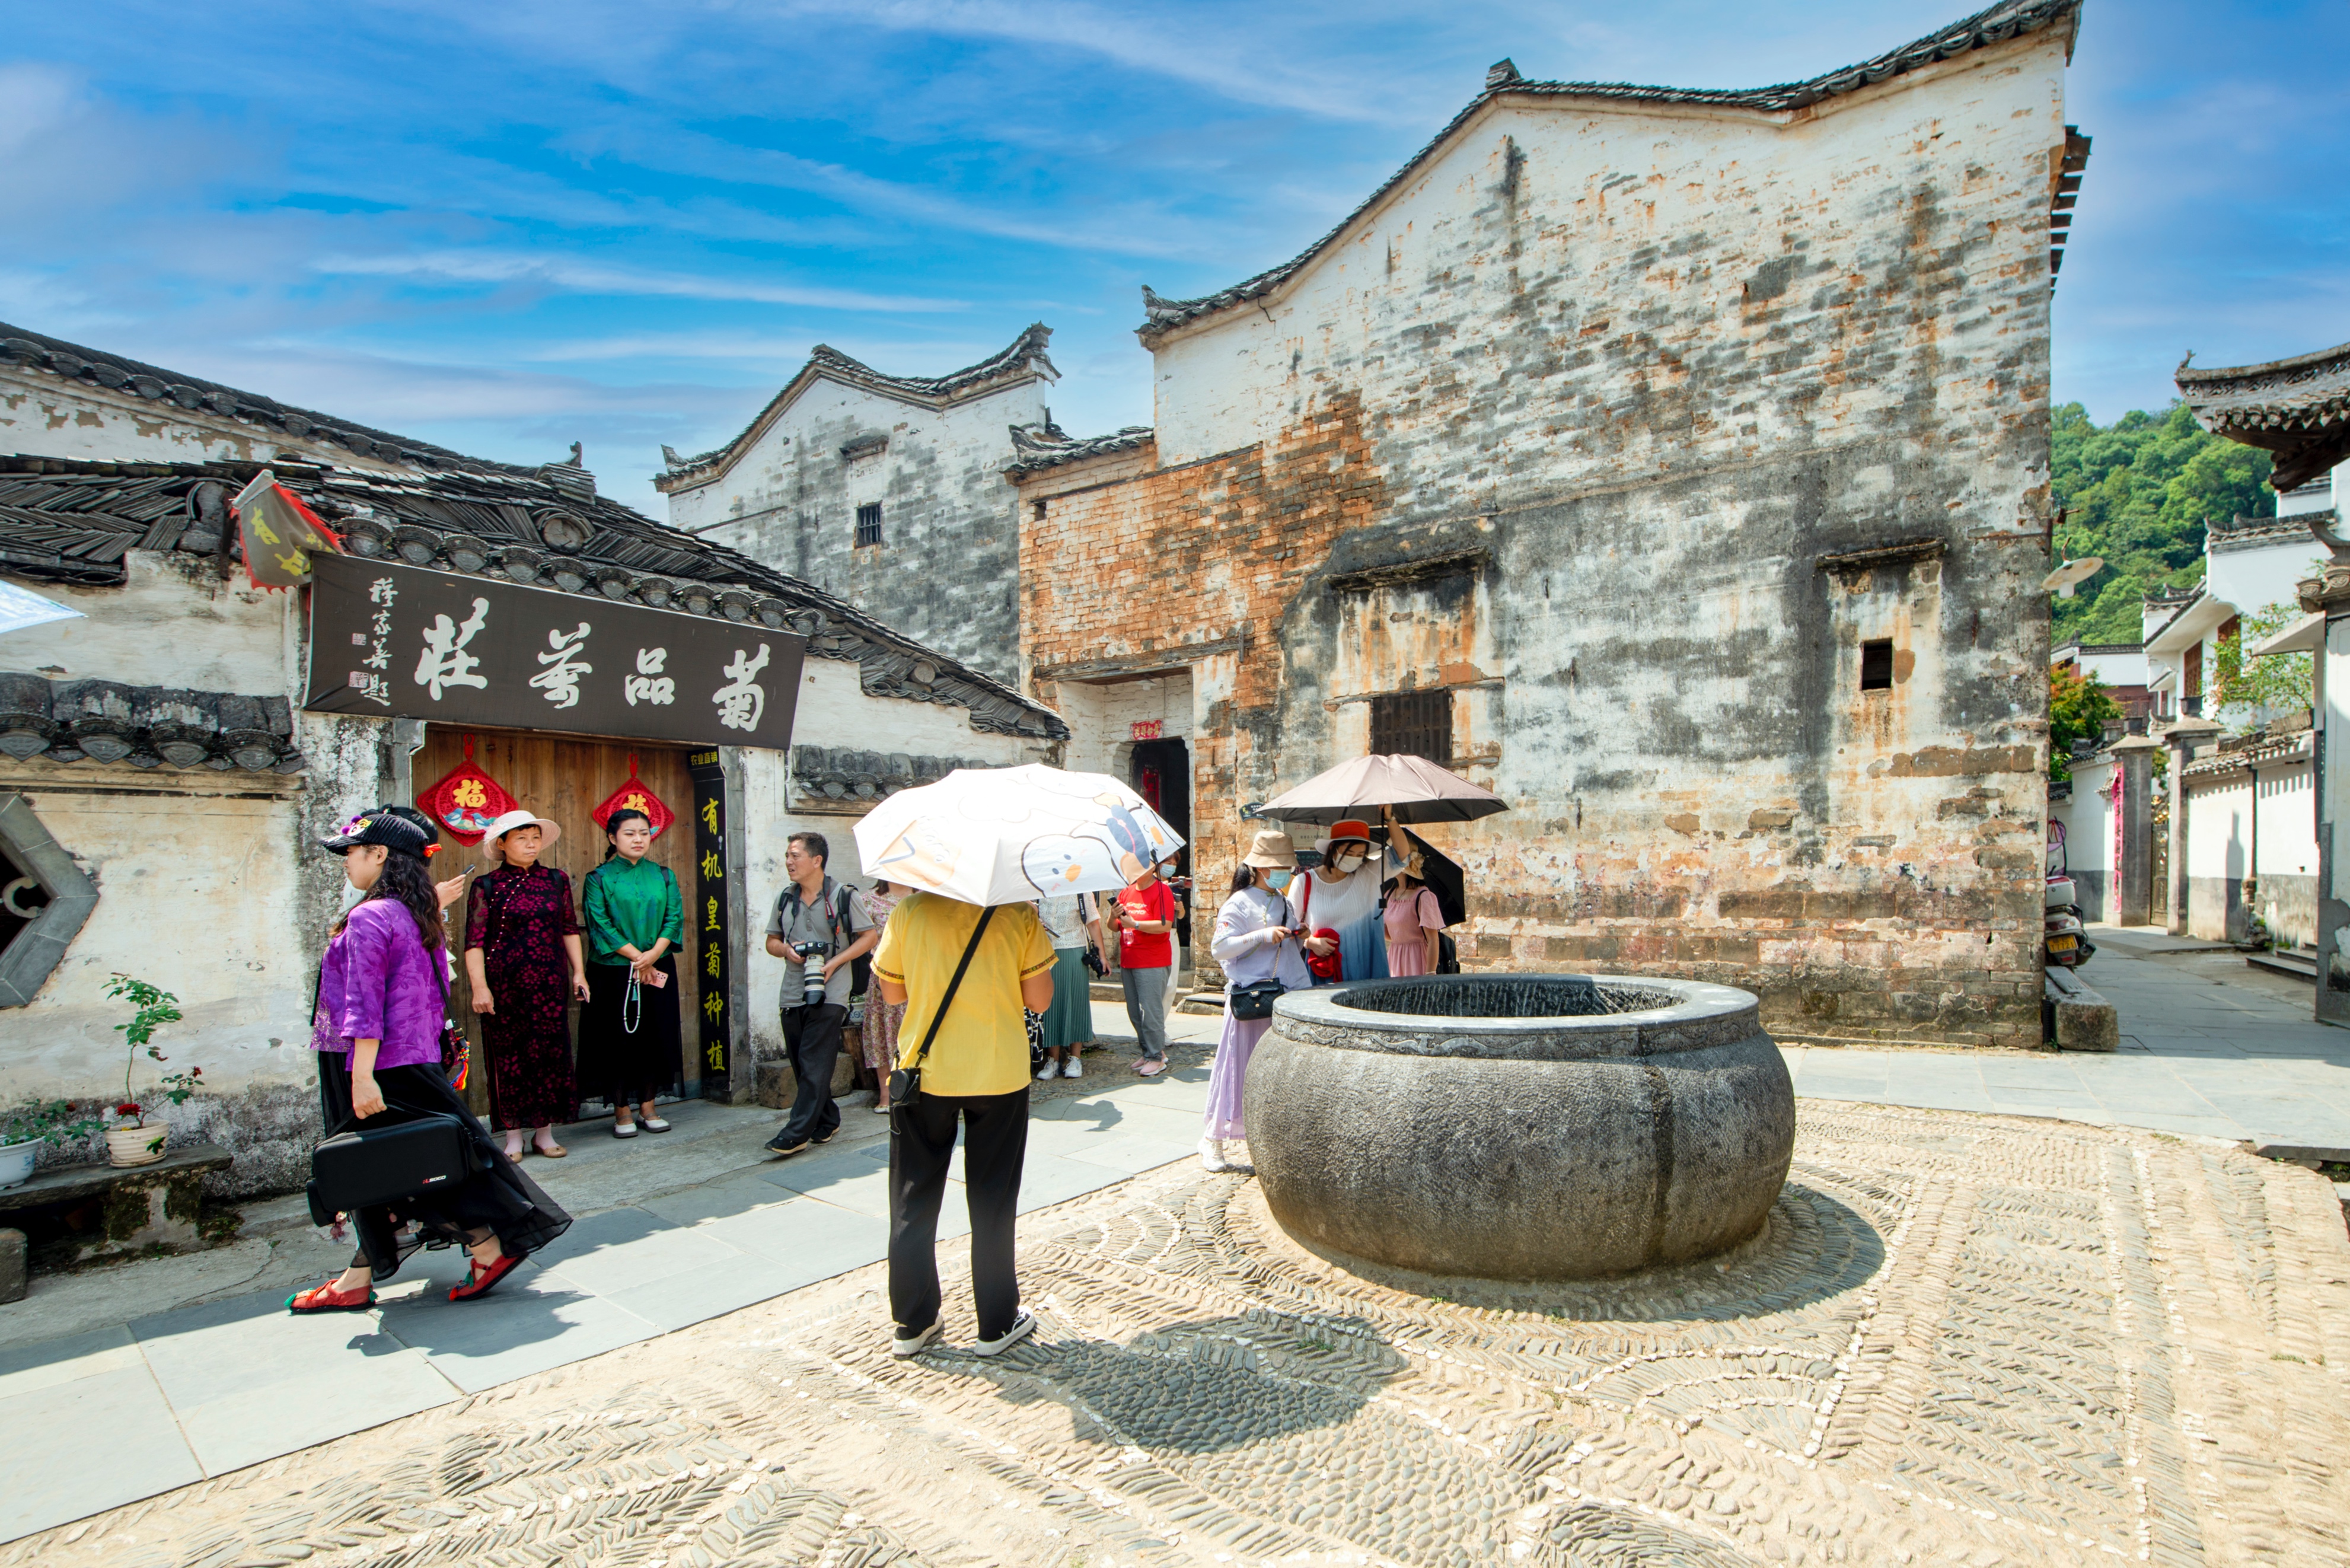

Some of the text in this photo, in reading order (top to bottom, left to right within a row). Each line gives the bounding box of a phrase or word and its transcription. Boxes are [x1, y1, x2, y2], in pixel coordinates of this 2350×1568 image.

[453, 779, 487, 808] 福
[701, 798, 726, 1071] 有机皇菊种植
